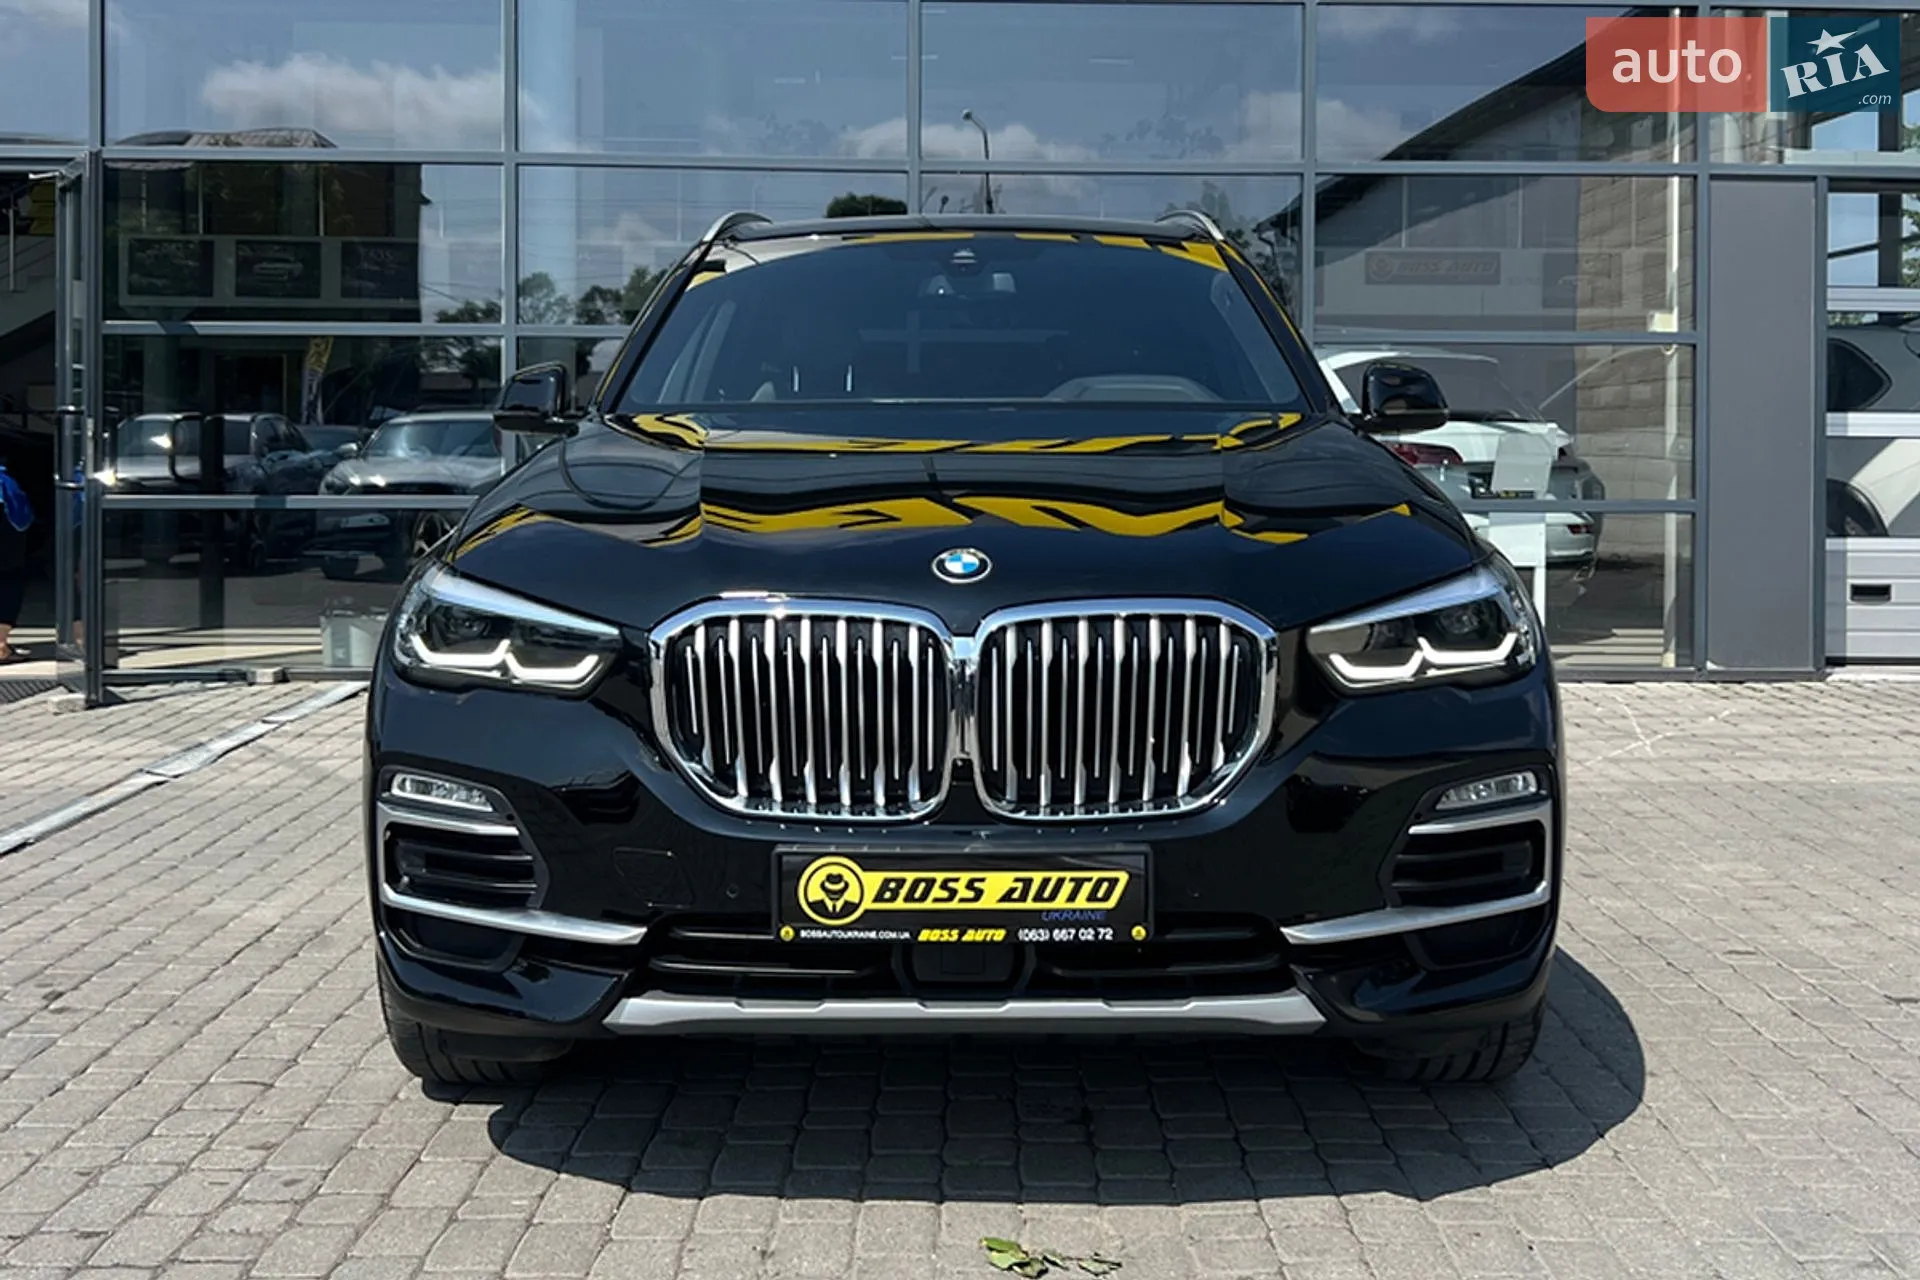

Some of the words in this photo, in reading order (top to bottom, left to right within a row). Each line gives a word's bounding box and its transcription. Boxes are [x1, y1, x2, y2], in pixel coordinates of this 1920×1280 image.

[871, 876, 987, 903] BOSS
[997, 876, 1120, 903] AUTO
[1041, 910, 1107, 921] UKRAINE
[917, 928, 959, 942] BOSS
[961, 928, 1007, 942] AUTO
[1018, 928, 1050, 942] (063)
[1053, 928, 1074, 942] 667
[1078, 927, 1095, 941] 02
[1098, 927, 1114, 941] 72
